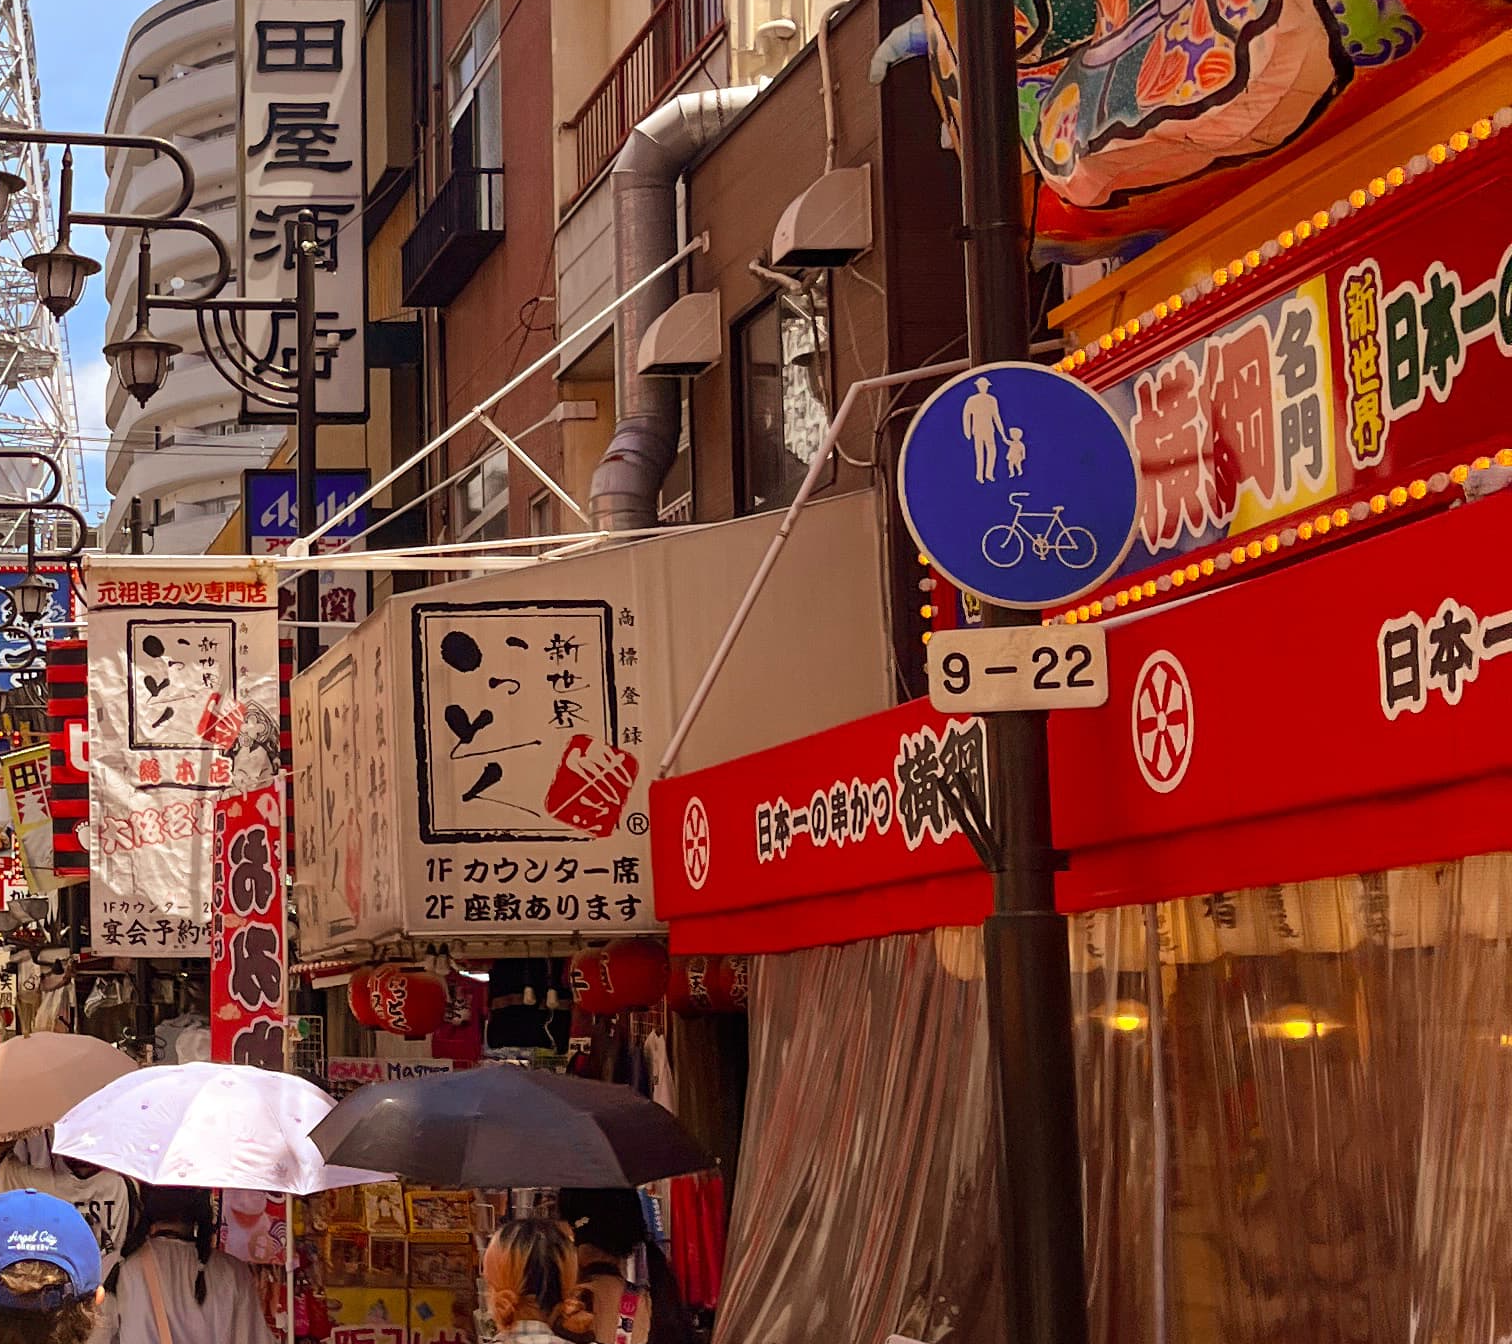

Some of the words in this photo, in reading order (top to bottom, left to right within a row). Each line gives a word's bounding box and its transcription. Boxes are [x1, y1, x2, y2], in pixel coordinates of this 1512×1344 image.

[1346, 273, 1384, 460] 新世界
[1384, 248, 1512, 411] 日本一
[1134, 326, 1274, 546] 横綱
[1275, 307, 1324, 494] 名門
[97, 580, 268, 604] 元祖串カツ専門店
[543, 633, 591, 730] 新世界
[618, 607, 644, 746] 商標登録
[139, 758, 234, 785] 総本店
[757, 782, 891, 855] 日本一の串かつ
[898, 719, 988, 844] 横綱
[202, 901, 214, 914] 2
[425, 894, 455, 921] 2F
[463, 892, 643, 923] 座敷あります
[426, 857, 454, 883] 1F
[463, 856, 640, 885] カウンター席
